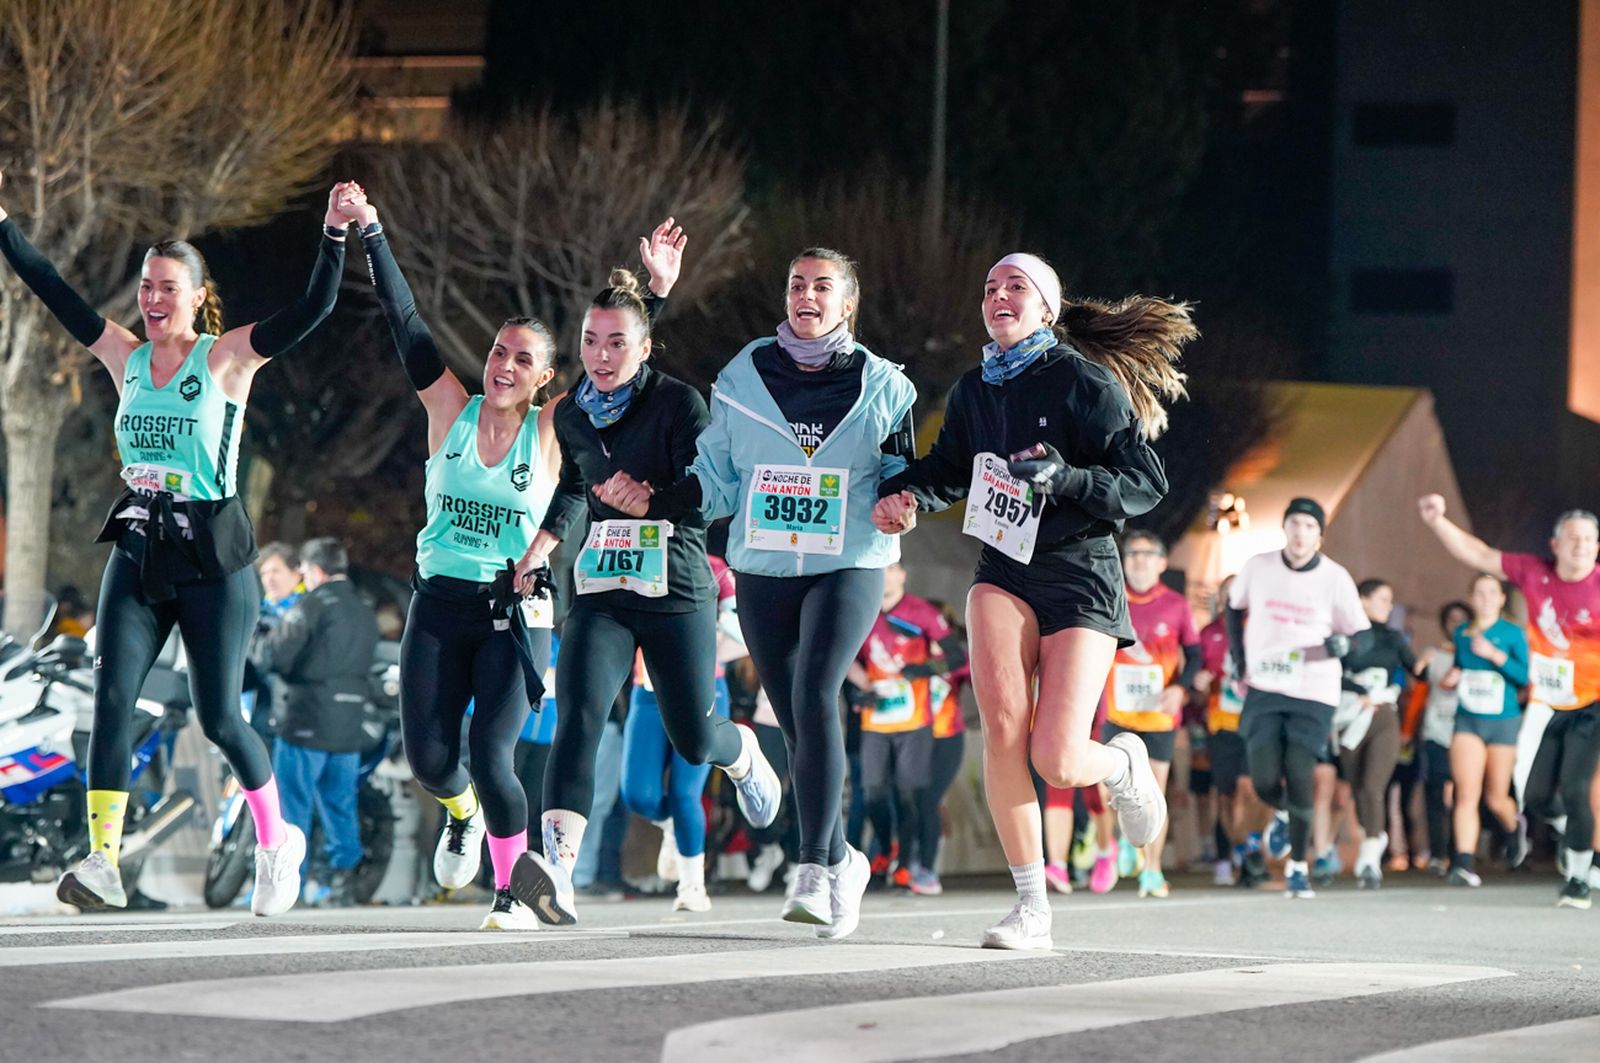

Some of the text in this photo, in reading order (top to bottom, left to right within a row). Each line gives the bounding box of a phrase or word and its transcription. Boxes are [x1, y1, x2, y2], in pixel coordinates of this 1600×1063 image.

[117, 414, 198, 436] ROSSFIT
[129, 433, 175, 450] JAEN
[771, 474, 799, 484] NOCHE
[800, 475, 812, 485] DE
[759, 483, 778, 494] SAN
[778, 483, 811, 496] ANTÓN
[764, 495, 828, 525] 3932
[985, 487, 1031, 528] 2957
[451, 514, 501, 538] JAEN
[607, 528, 631, 537] CHE DE
